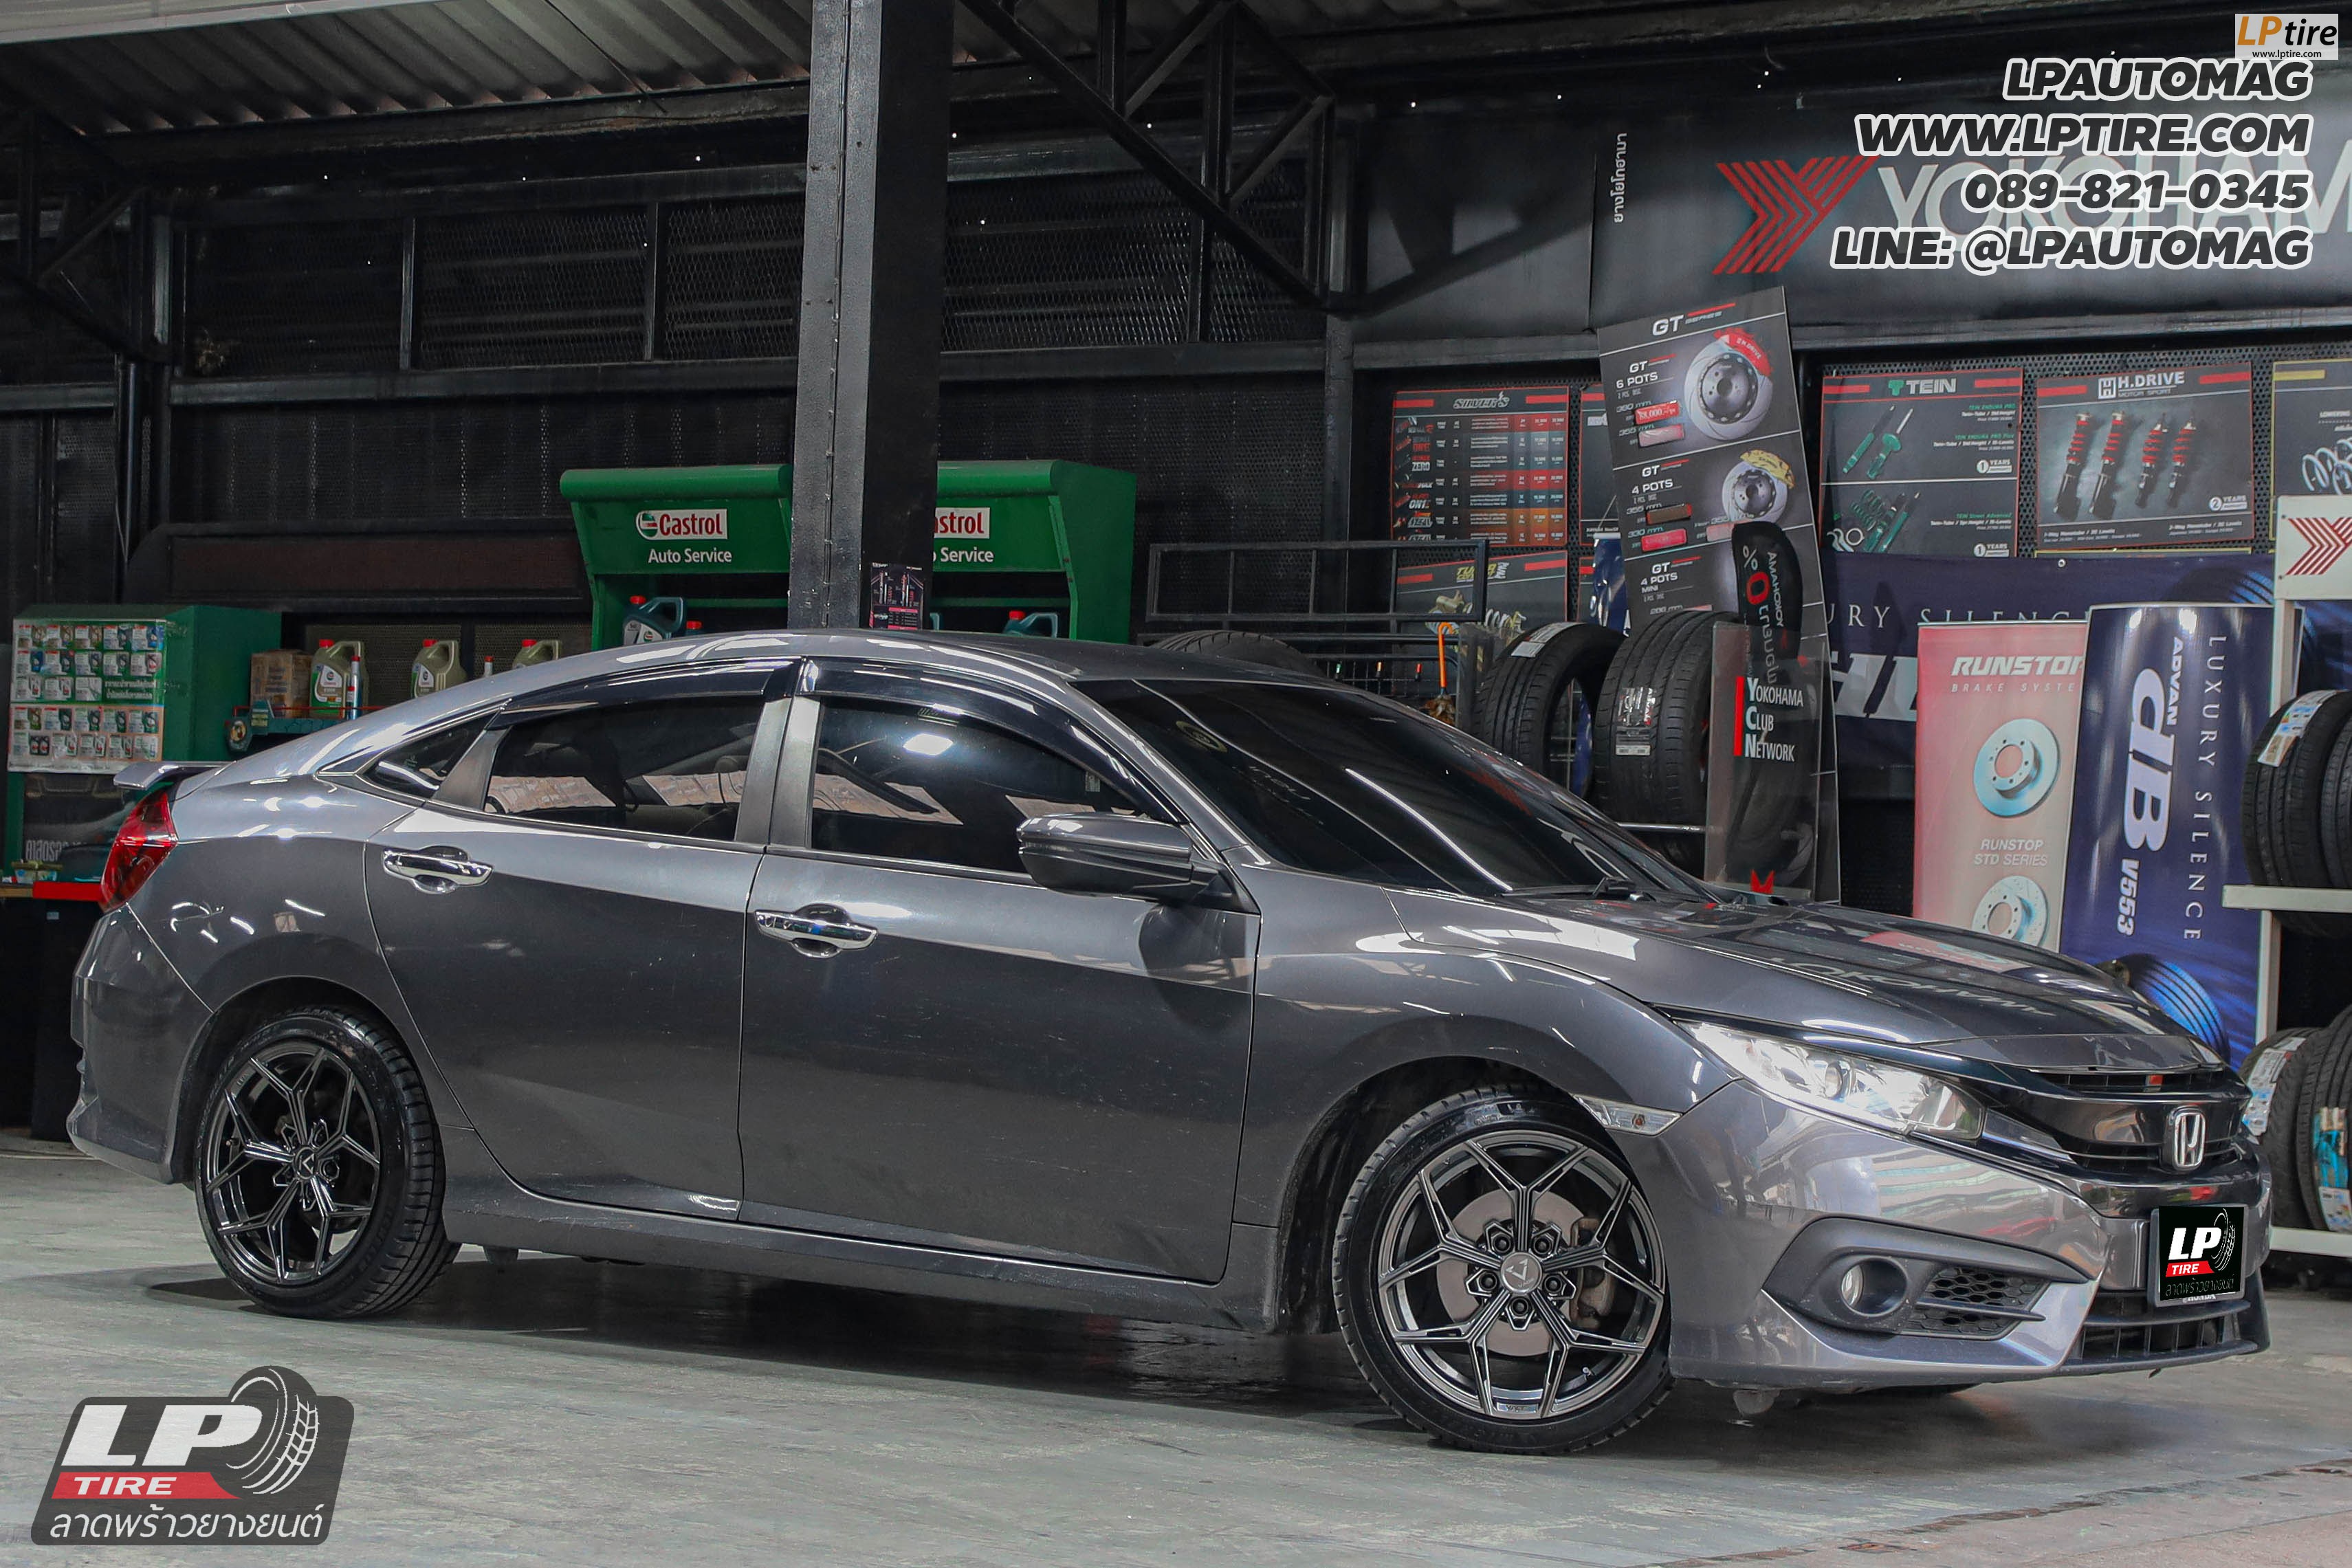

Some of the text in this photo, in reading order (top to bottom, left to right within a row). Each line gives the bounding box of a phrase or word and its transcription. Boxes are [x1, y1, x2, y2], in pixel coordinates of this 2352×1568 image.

[1651, 314, 1684, 336] GT
[1629, 360, 1648, 373] GT
[1616, 372, 1658, 388] 6 POTS
[1906, 377, 1957, 395] TEIN
[2118, 372, 2185, 388] H.DRIVE
[1641, 465, 1660, 478] GT
[1631, 478, 1674, 495] 4 POTS
[659, 514, 723, 536] Castrol
[648, 547, 732, 563] Auto Service
[941, 546, 994, 562] Service
[1651, 562, 1671, 575] GT
[1640, 571, 1678, 586] 4 POTS
[1951, 683, 2004, 692] BRAKE
[2166, 635, 2186, 726] ADVAN
[1747, 677, 1804, 707] YOKOHAMA
[2182, 634, 2227, 942] LUXURY SILENCE
[1981, 839, 2043, 852] RUNSTOP
[1974, 854, 2048, 867] STD SERIES
[2117, 859, 2140, 936] V553
